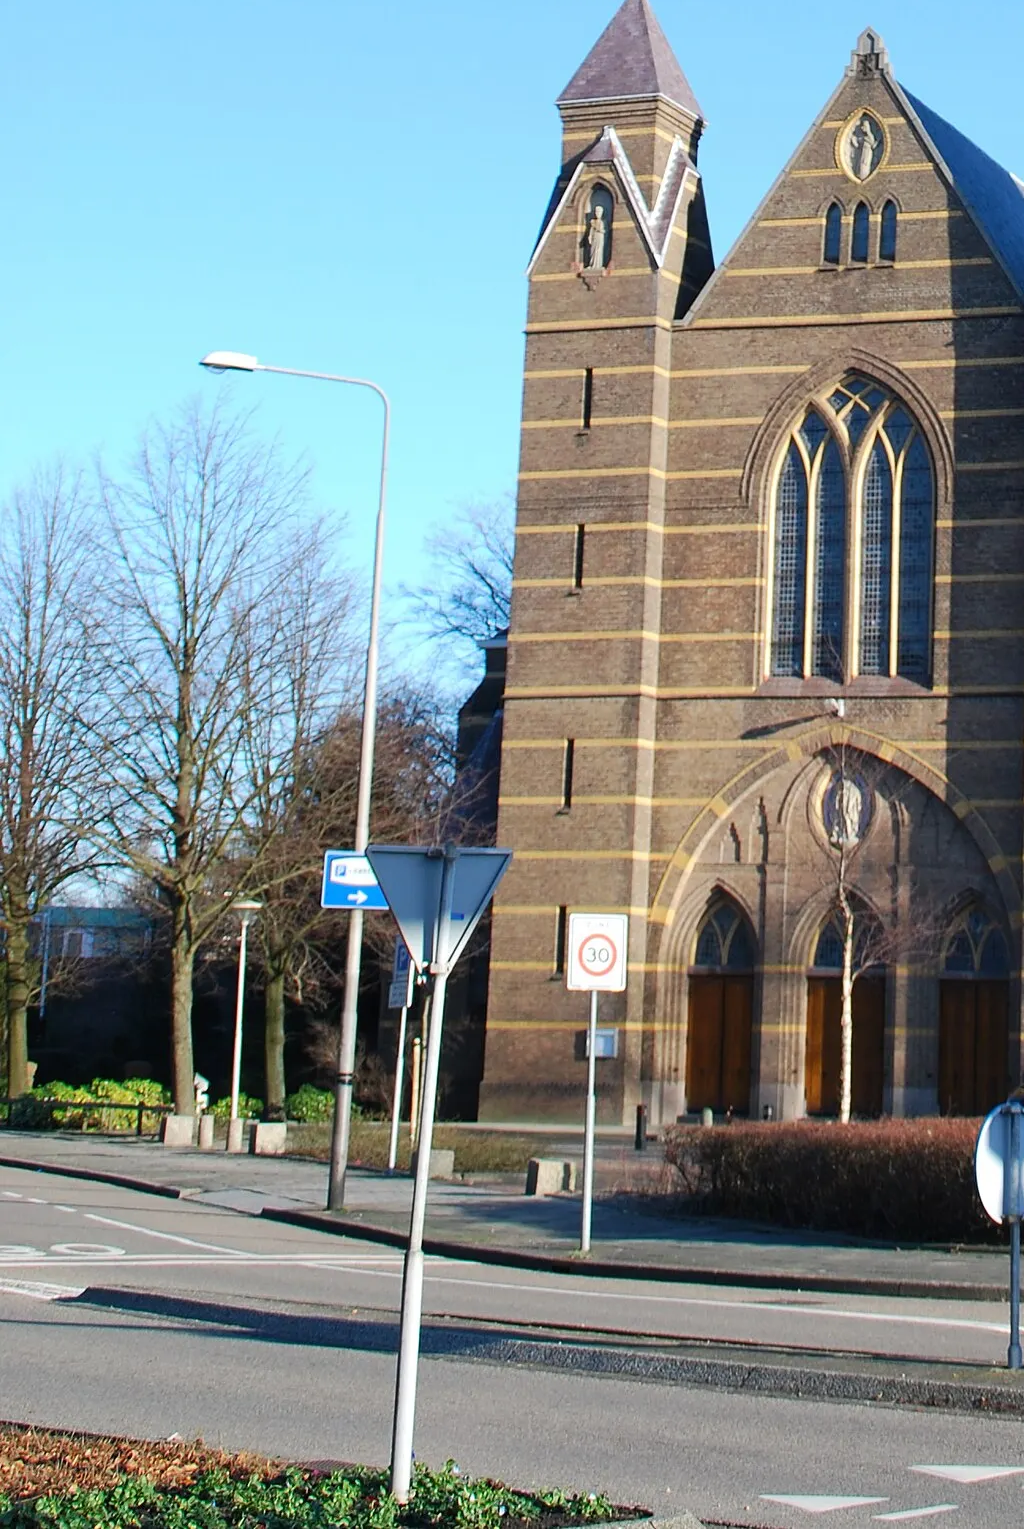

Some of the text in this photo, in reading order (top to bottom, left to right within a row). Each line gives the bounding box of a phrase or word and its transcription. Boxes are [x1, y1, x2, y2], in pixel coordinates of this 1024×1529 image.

[336, 865, 345, 877] P
[399, 946, 407, 969] P
[586, 947, 609, 963] 30
